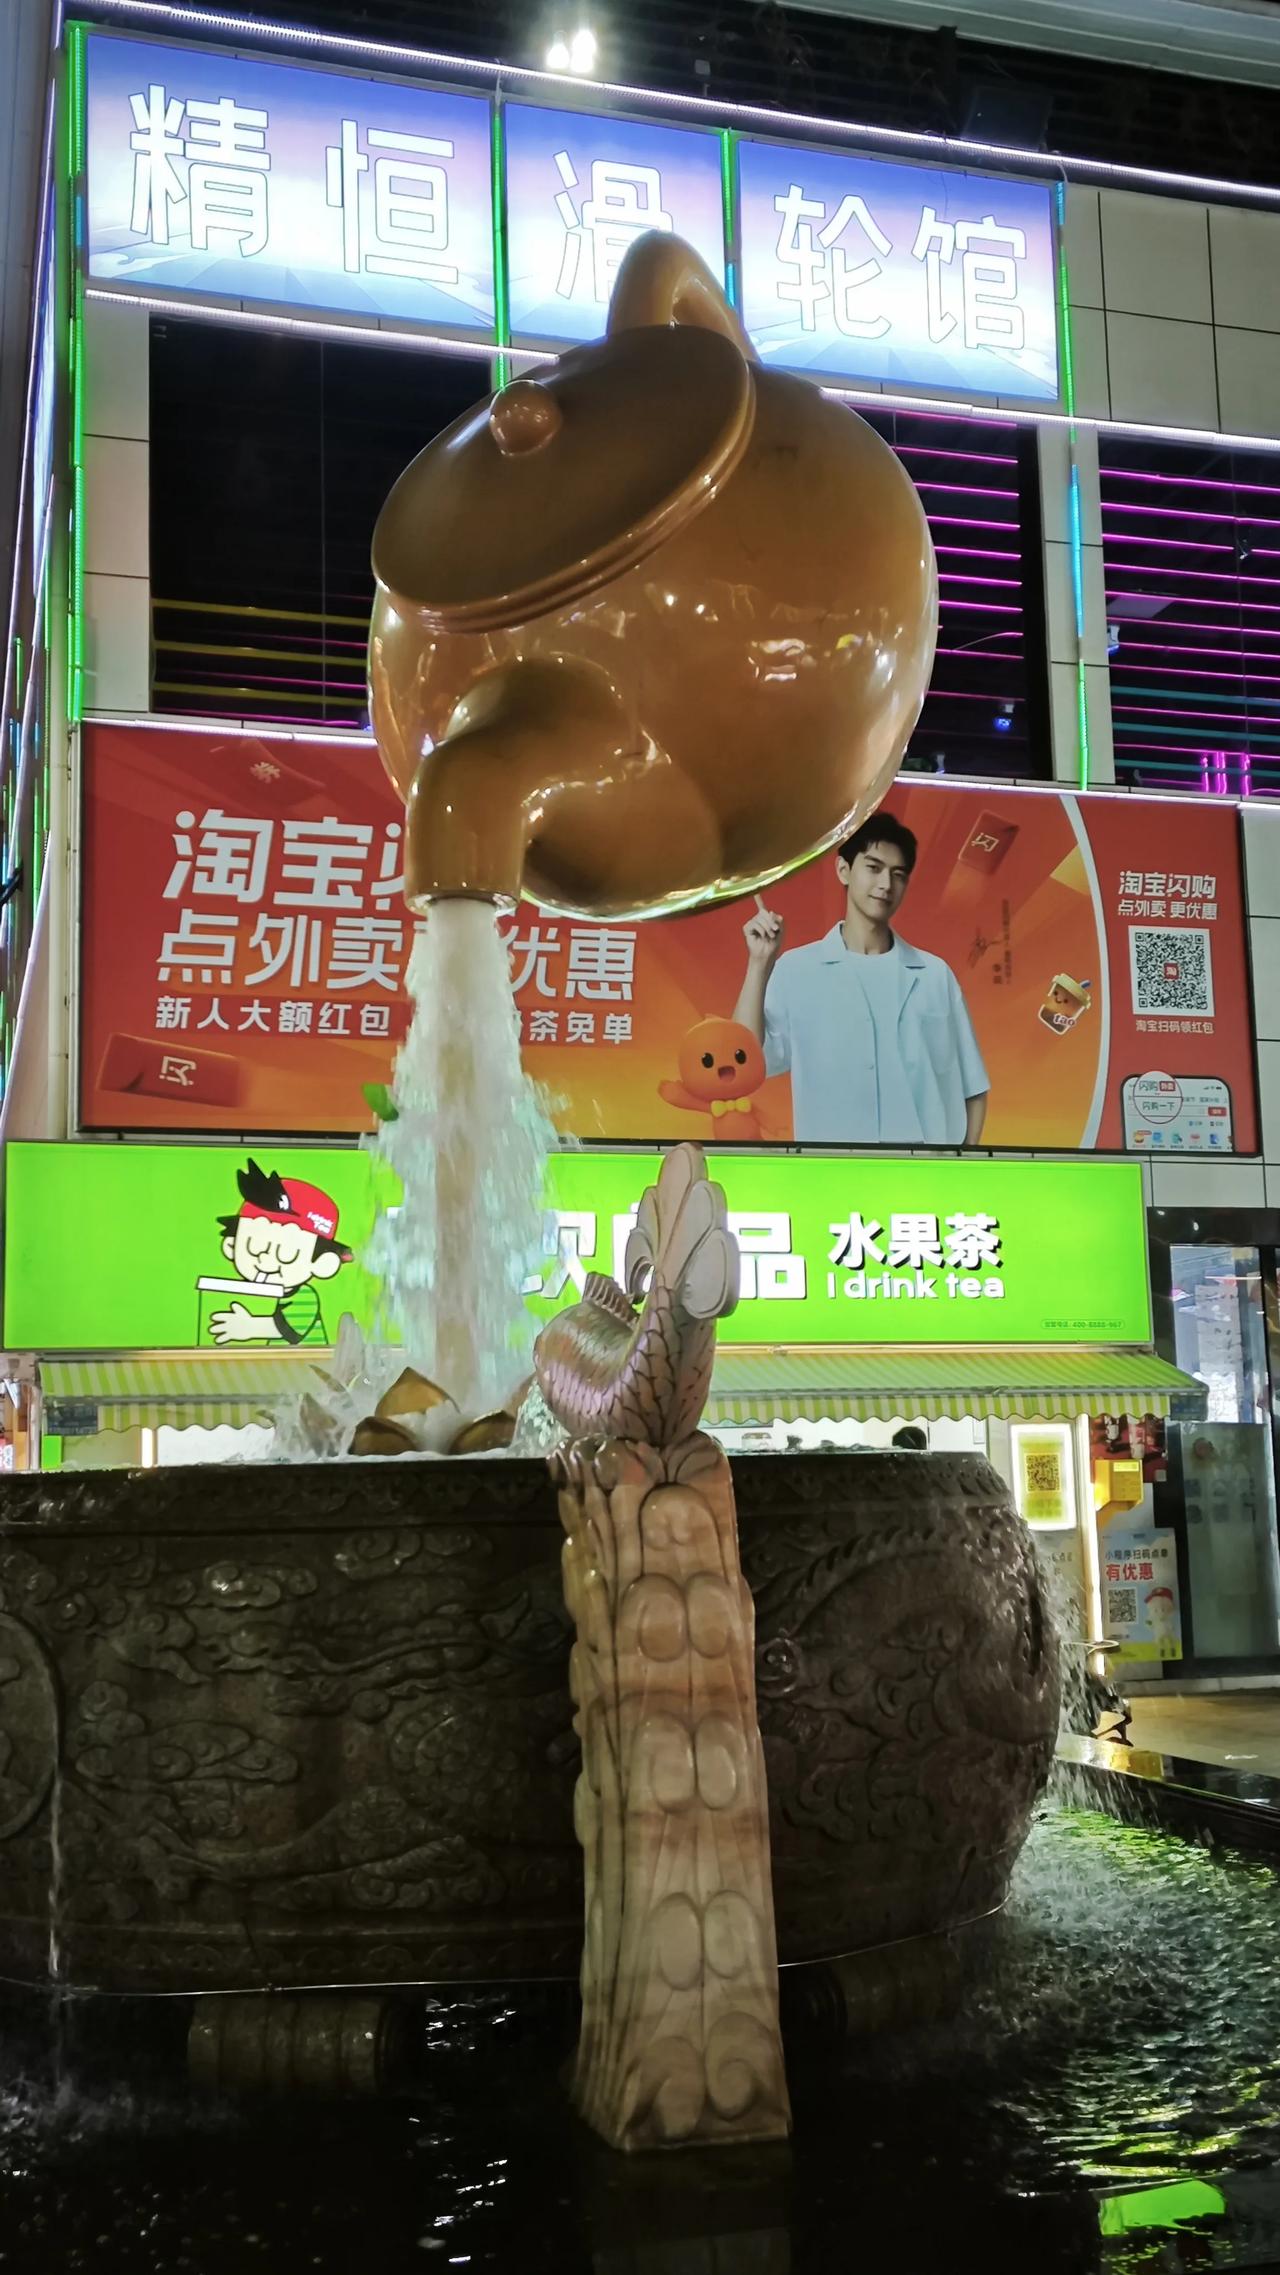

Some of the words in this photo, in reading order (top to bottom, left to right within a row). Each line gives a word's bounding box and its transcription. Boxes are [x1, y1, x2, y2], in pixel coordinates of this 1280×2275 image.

[1118, 871, 1217, 899] 淘宝闪购
[156, 908, 637, 1001] 点外卖优惠
[155, 995, 390, 1036] 新人大额红包
[1136, 1020, 1214, 1034] 淘宝扫码领红包
[827, 1211, 1003, 1270] 水果茶
[827, 1272, 836, 1299] I
[844, 1271, 940, 1299] drink
[945, 1272, 1005, 1299] tea
[1105, 1562, 1154, 1581] 有优惠
